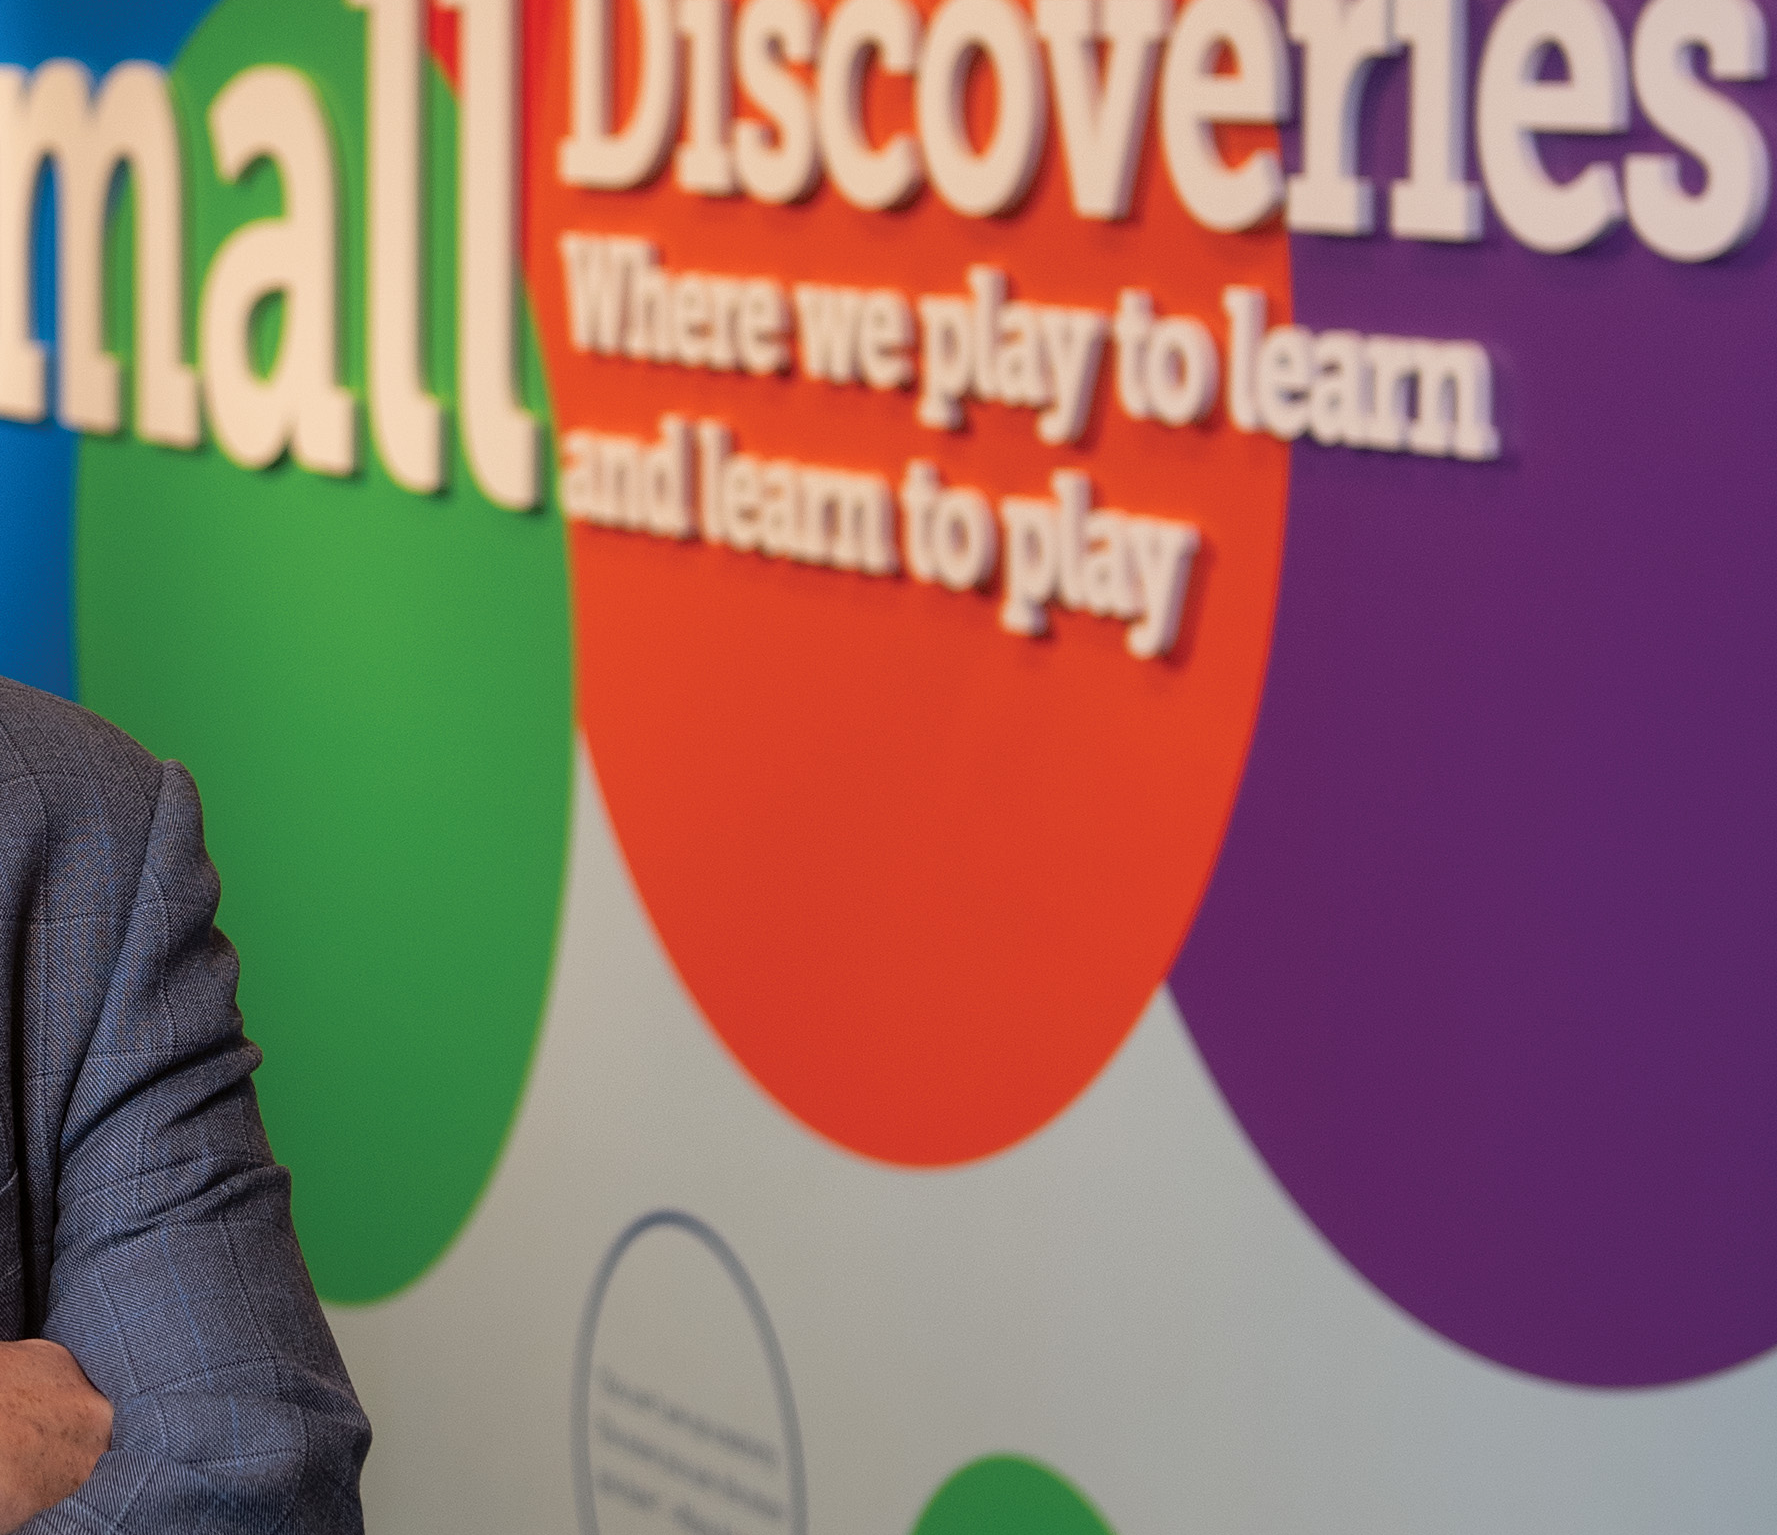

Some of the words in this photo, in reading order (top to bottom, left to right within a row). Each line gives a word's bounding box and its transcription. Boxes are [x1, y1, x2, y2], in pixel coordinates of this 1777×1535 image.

[561, 233, 788, 375] Where
[795, 281, 914, 388] we
[917, 265, 1104, 443] play
[1116, 287, 1219, 425] to
[1222, 285, 1500, 461] learn
[560, 415, 698, 539] and
[700, 418, 899, 575] learn
[902, 459, 994, 591] to
[1000, 468, 1201, 659] play
